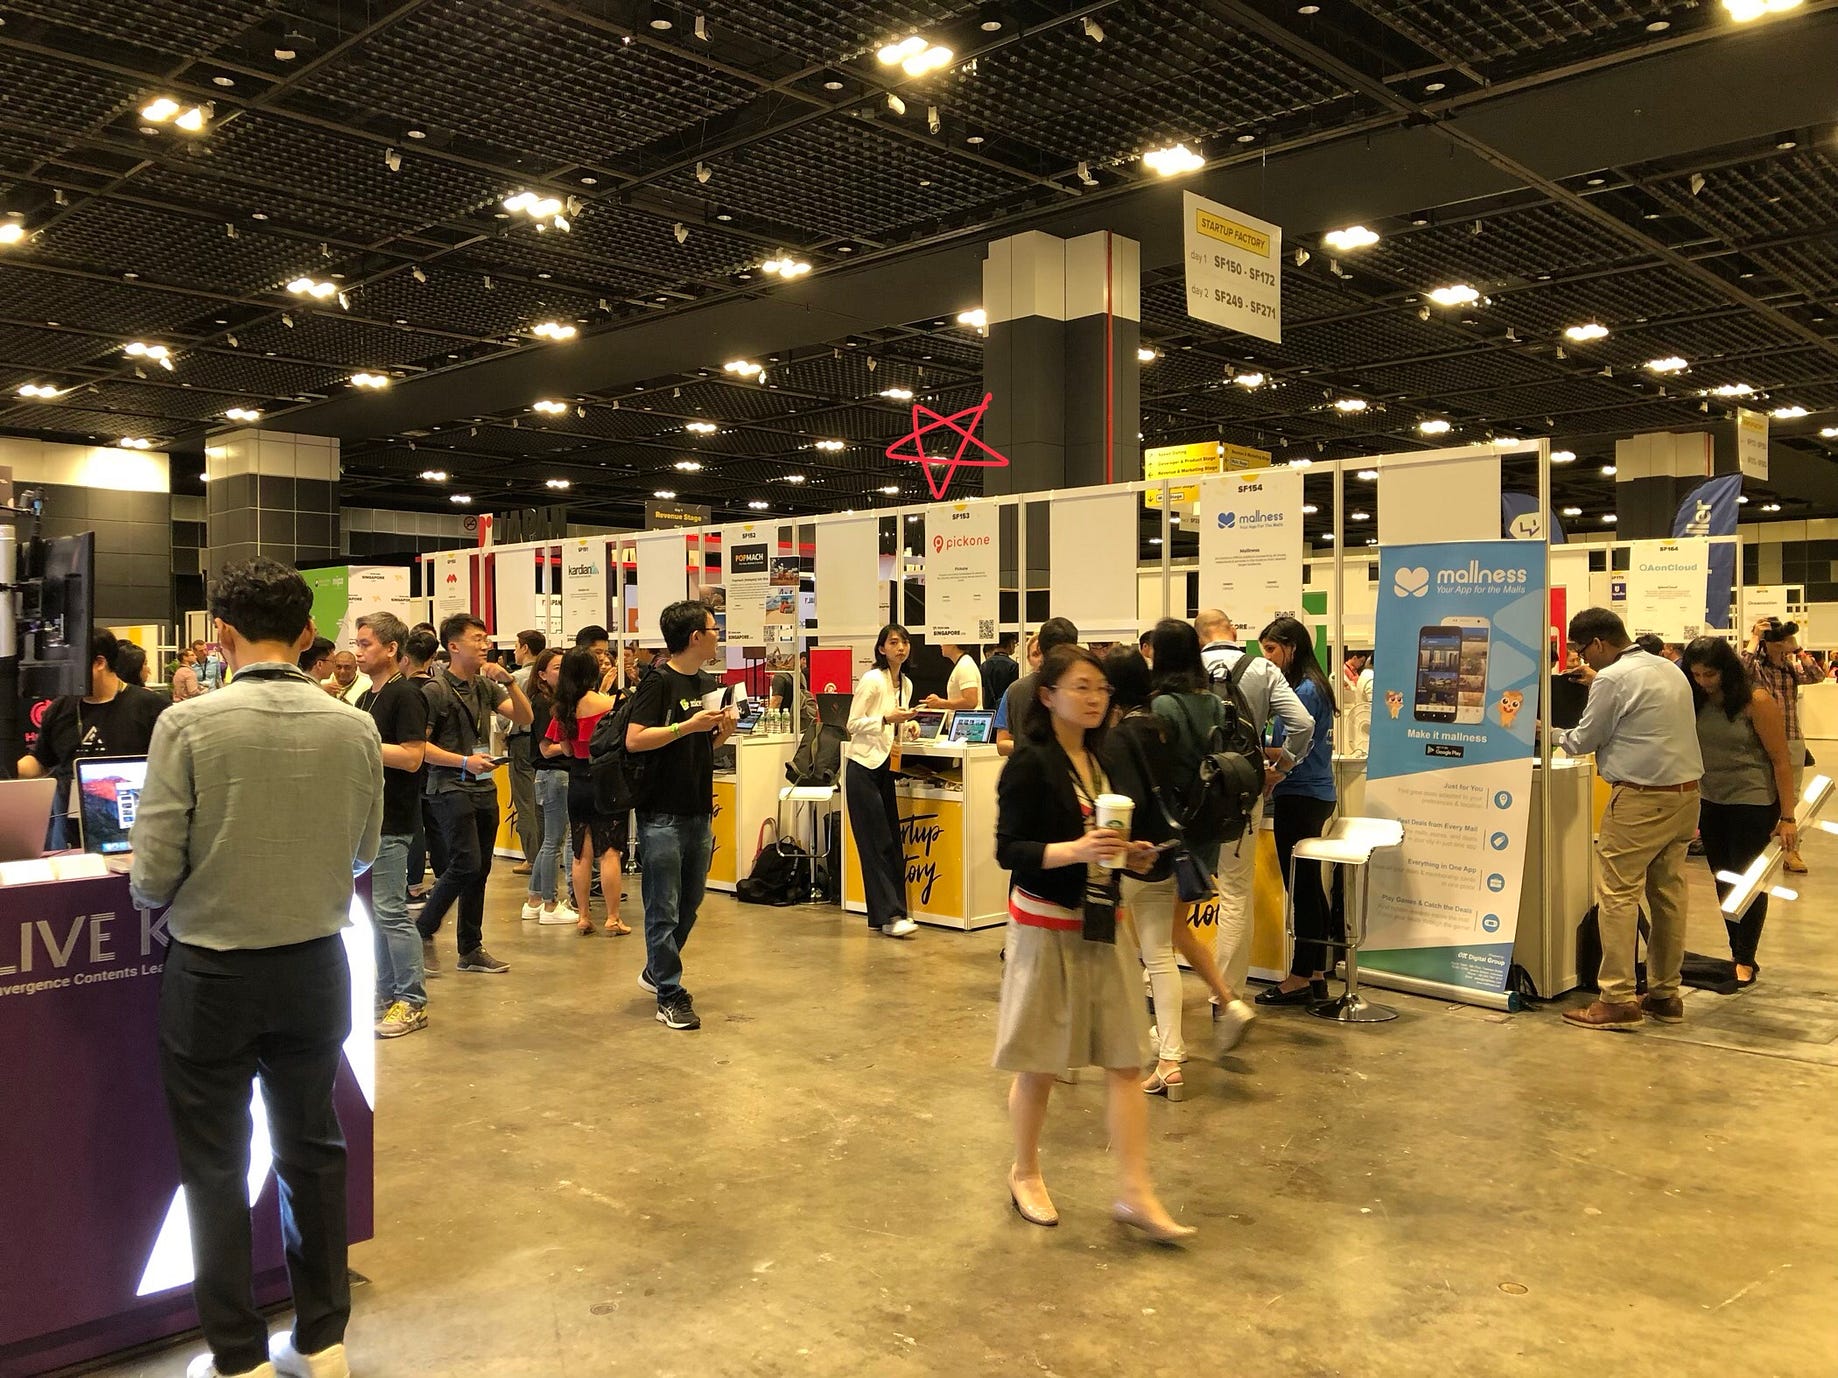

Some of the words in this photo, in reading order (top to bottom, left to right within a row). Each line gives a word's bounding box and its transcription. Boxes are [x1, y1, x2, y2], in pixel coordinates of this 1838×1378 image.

[1201, 217, 1234, 237] STARTUP
[1234, 228, 1266, 249] FACTORY
[1190, 251, 1203, 265] day
[1214, 255, 1242, 276] SF150
[1249, 267, 1276, 287] SF172
[1191, 285, 1203, 298] day
[1204, 288, 1209, 298] 2
[1214, 289, 1243, 309] SF249
[1250, 301, 1276, 319] SF271
[1238, 484, 1263, 493] SF154
[655, 511, 683, 520] Revenue
[683, 513, 702, 522] Stage
[1239, 510, 1284, 524] mallness
[946, 535, 990, 551] pickone
[735, 553, 764, 562] POPMACH
[568, 564, 592, 576] kardian
[1436, 559, 1528, 584] mallness
[1436, 585, 1454, 594] Your
[1454, 586, 1472, 595] App
[1474, 585, 1486, 594] for
[1487, 586, 1501, 594] the
[1502, 586, 1526, 594] Malls
[1407, 728, 1431, 740] Make
[1432, 730, 1441, 740] it
[1441, 731, 1488, 744] mallness
[1435, 748, 1452, 757] Google
[1452, 749, 1462, 757] Play
[1470, 784, 1484, 792] You
[1411, 819, 1427, 827] Deals
[1444, 822, 1463, 832] Every
[1464, 824, 1479, 832] Mall
[1408, 858, 1440, 870] Everything
[1448, 864, 1462, 872] One
[1463, 866, 1477, 875] App
[1382, 894, 1394, 902] Play
[1396, 896, 1417, 905] Games
[1424, 901, 1443, 909] Catch
[1455, 905, 1472, 914] Deals
[1468, 953, 1487, 962] Digital
[1487, 957, 1505, 967] Group
[73, 967, 138, 986] Contents
[141, 962, 165, 976] Lea
